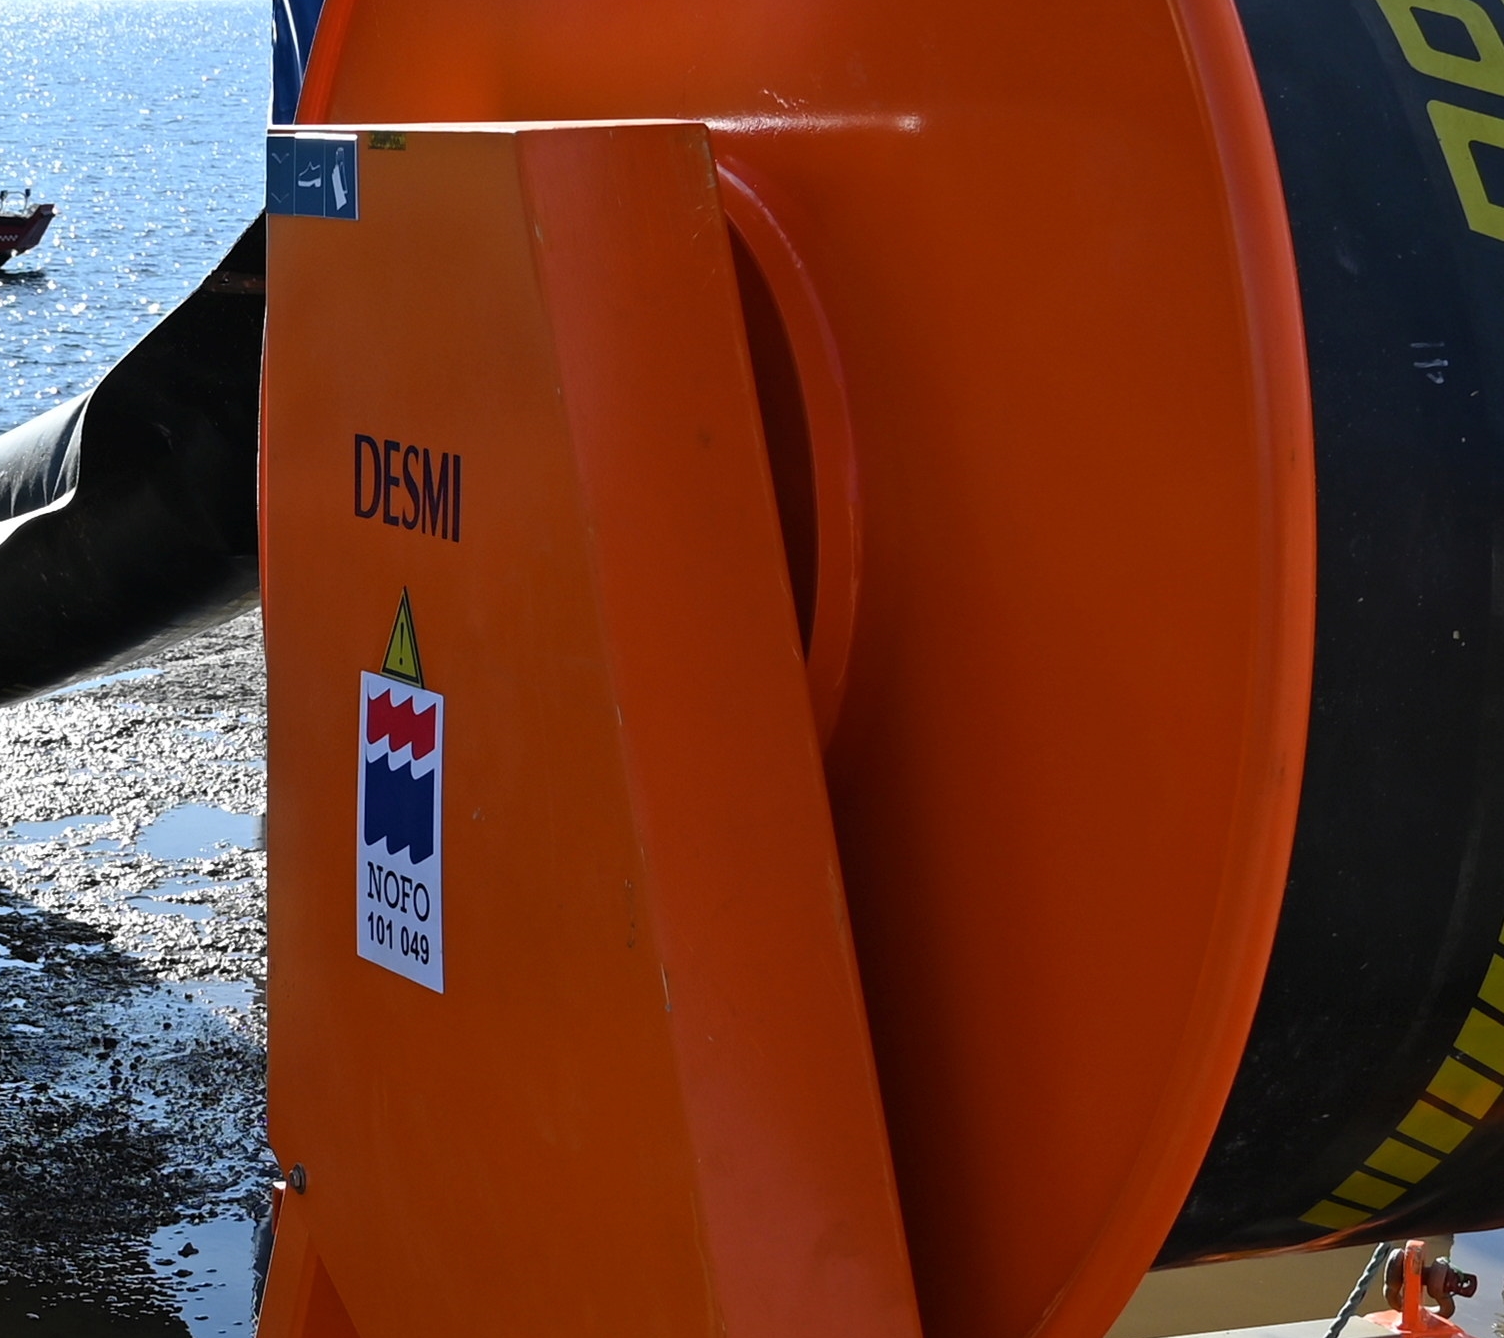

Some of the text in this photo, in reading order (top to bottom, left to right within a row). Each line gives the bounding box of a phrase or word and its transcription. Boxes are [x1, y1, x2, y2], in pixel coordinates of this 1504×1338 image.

[354, 433, 462, 543] DESMI
[367, 858, 430, 924] NOFO
[366, 910, 430, 967] 101 049
